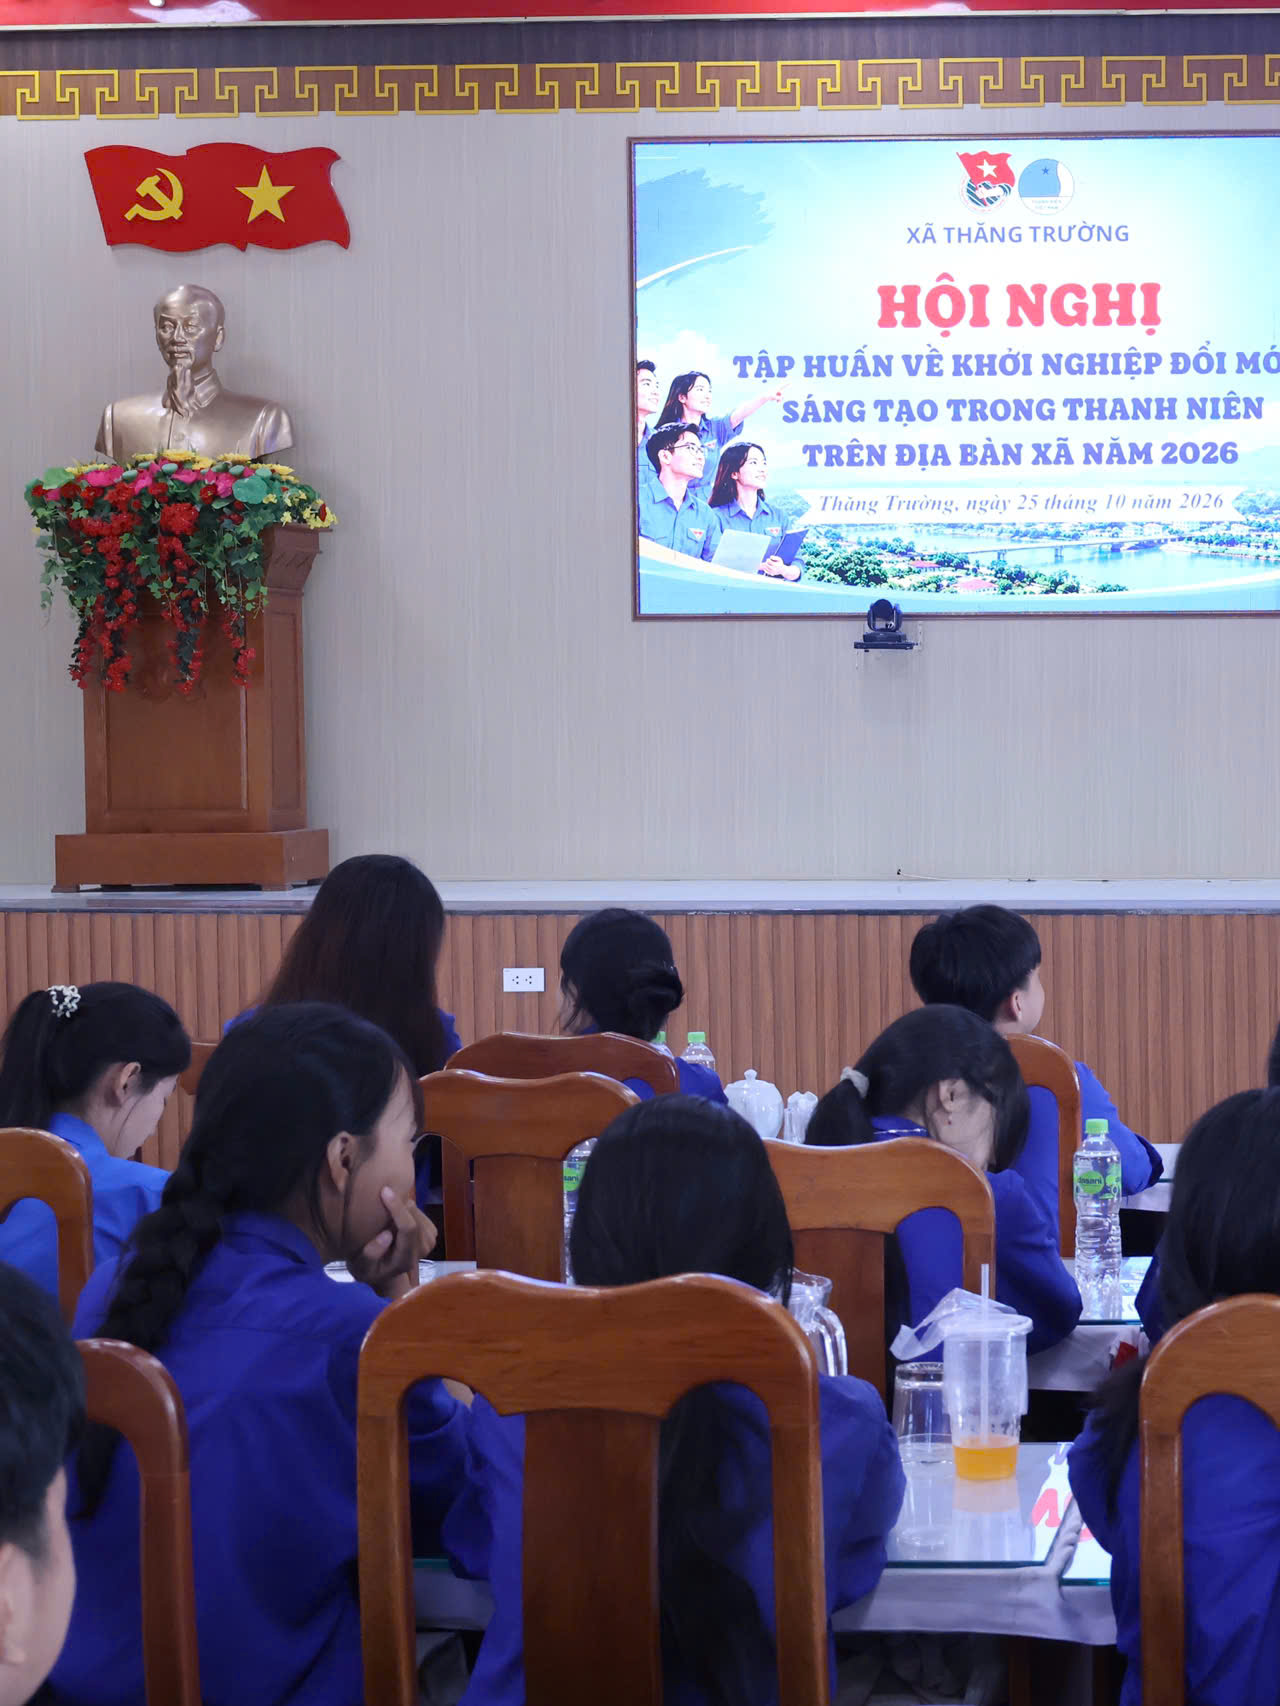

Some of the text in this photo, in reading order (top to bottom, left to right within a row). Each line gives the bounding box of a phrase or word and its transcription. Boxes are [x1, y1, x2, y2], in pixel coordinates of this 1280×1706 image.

[907, 221, 1128, 243] XÃ THĂNG TRƯỜNG
[877, 272, 1161, 338] HỘI NGHỊ
[733, 349, 795, 383] TẬP
[804, 345, 893, 377] HUẤN
[902, 344, 943, 376] VỀ
[952, 348, 1032, 376] KHỞI
[1042, 346, 1162, 380] NGHIỆP
[1170, 341, 1226, 374] ĐỔI
[783, 391, 1264, 427] SÁNG TẠO TRONG THANH NIÊN
[802, 437, 1238, 471] TRÊN ĐỊA BÀN XÃ NĂM 2026
[820, 493, 1223, 515] Thăng Trường, ngày 25 tháng 10 năm 2026
